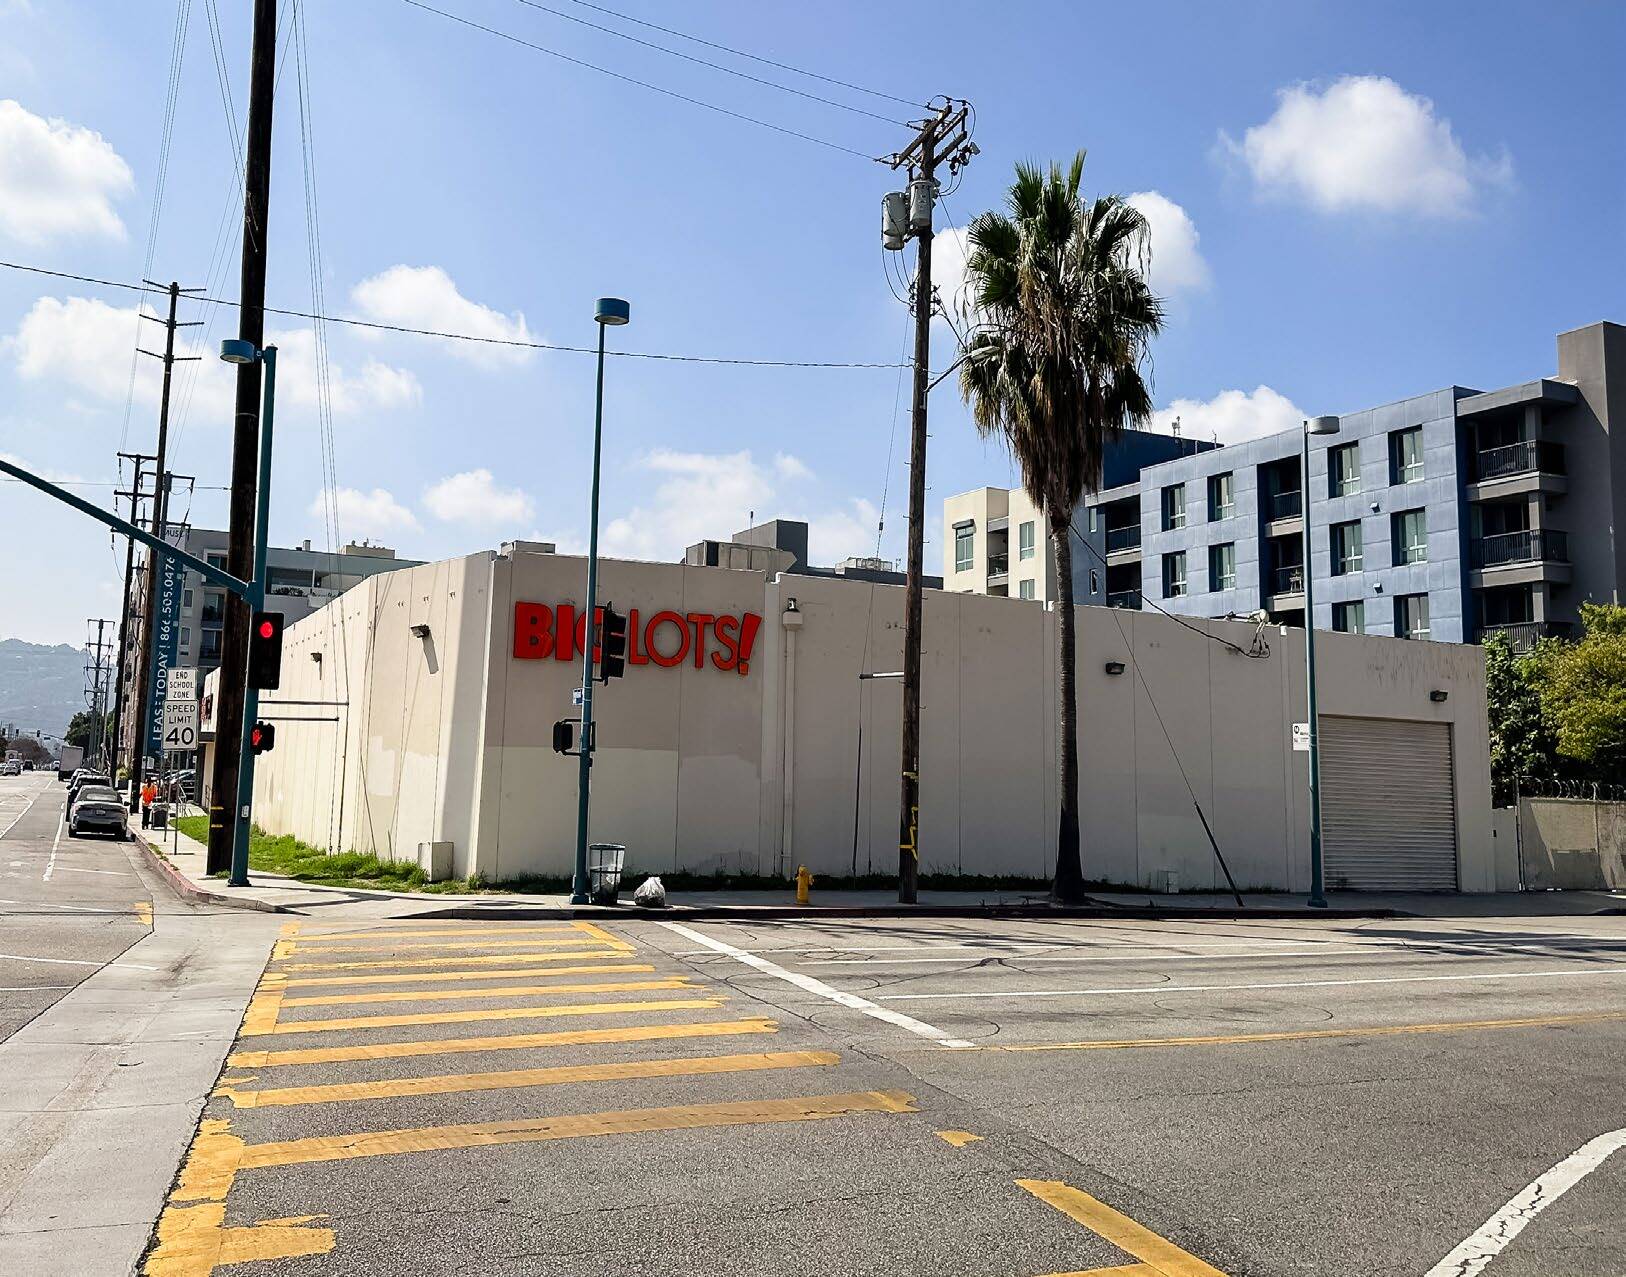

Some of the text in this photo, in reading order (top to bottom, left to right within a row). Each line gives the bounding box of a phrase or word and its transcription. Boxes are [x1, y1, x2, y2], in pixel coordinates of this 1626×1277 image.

[628, 608, 763, 676] LOTS!
[155, 651, 168, 697] TODAY
[175, 671, 188, 679] END
[169, 681, 194, 689] SCHOOL
[173, 690, 189, 698] ZONE
[166, 704, 195, 713] SPEED
[168, 715, 192, 724] LIMIT
[165, 726, 194, 745] 40
